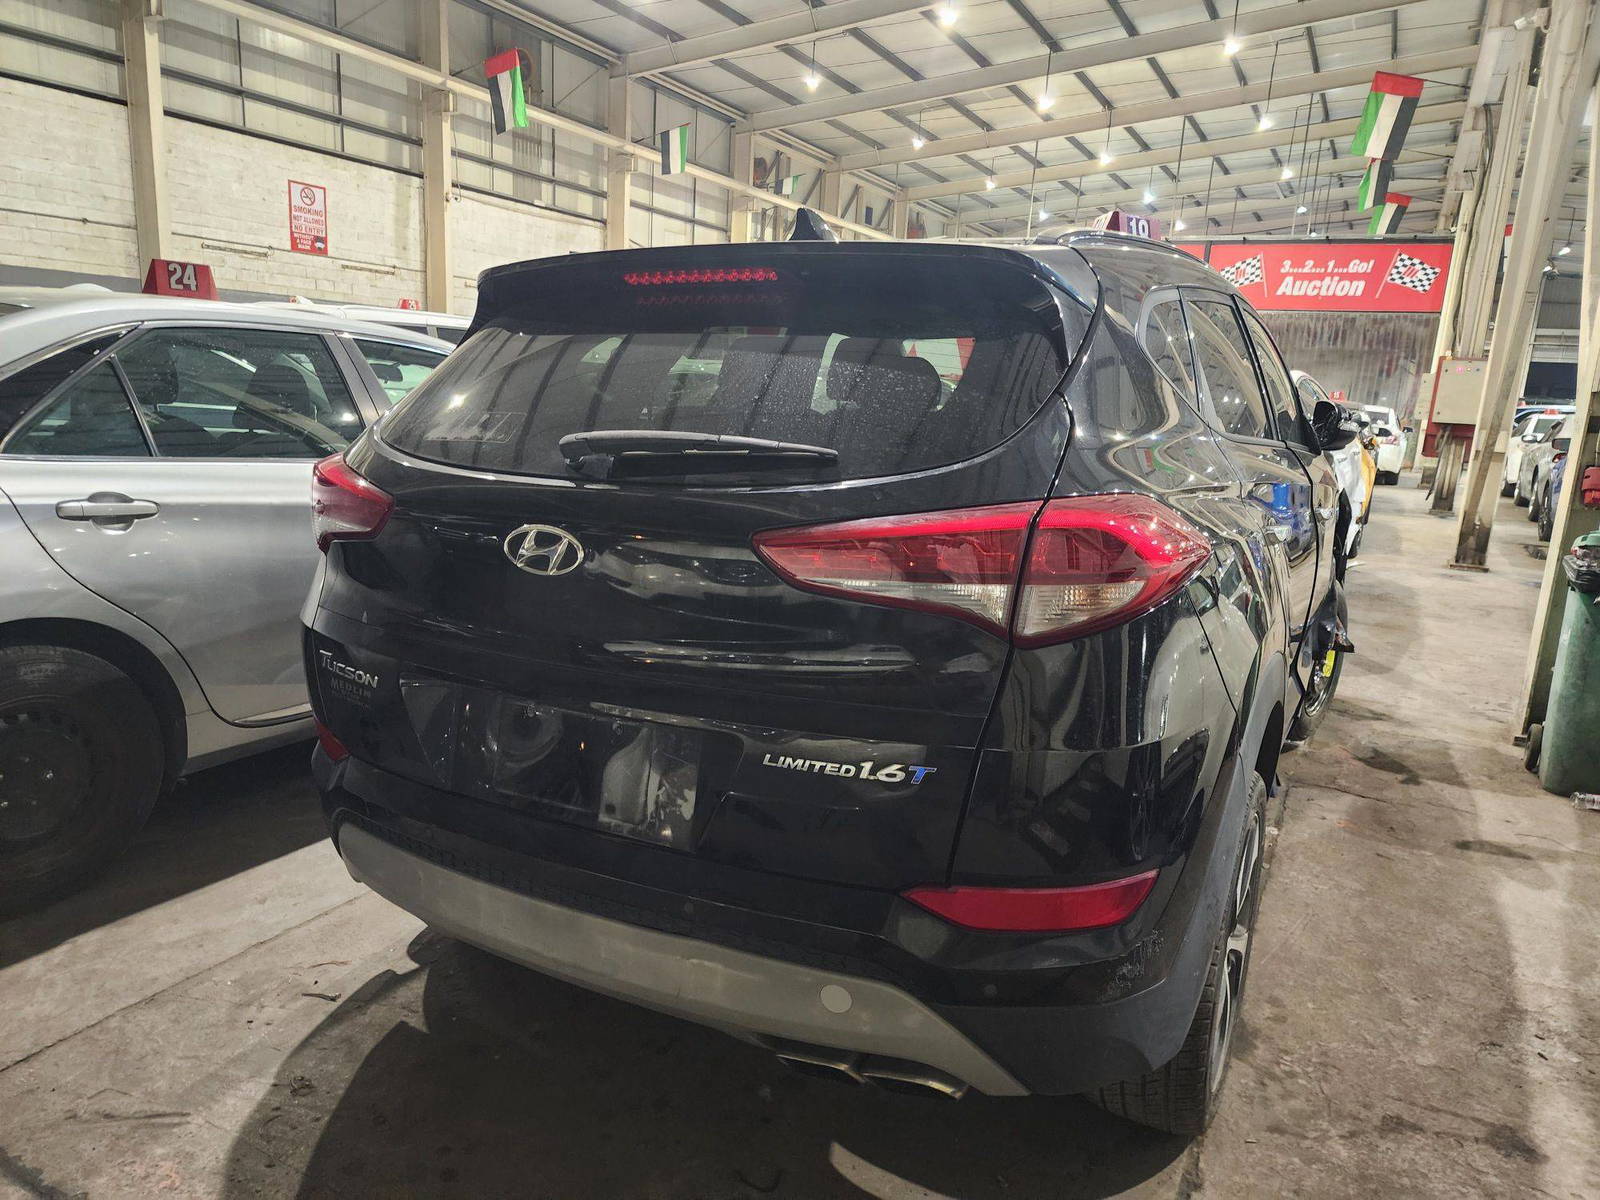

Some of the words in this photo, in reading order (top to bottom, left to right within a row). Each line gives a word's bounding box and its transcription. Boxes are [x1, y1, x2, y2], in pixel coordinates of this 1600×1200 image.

[293, 205, 323, 218] SMOKING
[294, 223, 303, 231] NO
[304, 225, 324, 235] ENTRY
[168, 262, 198, 292] 24
[1275, 276, 1367, 297] Auction
[319, 649, 379, 688] TUCSON
[762, 753, 856, 778] LIMITED
